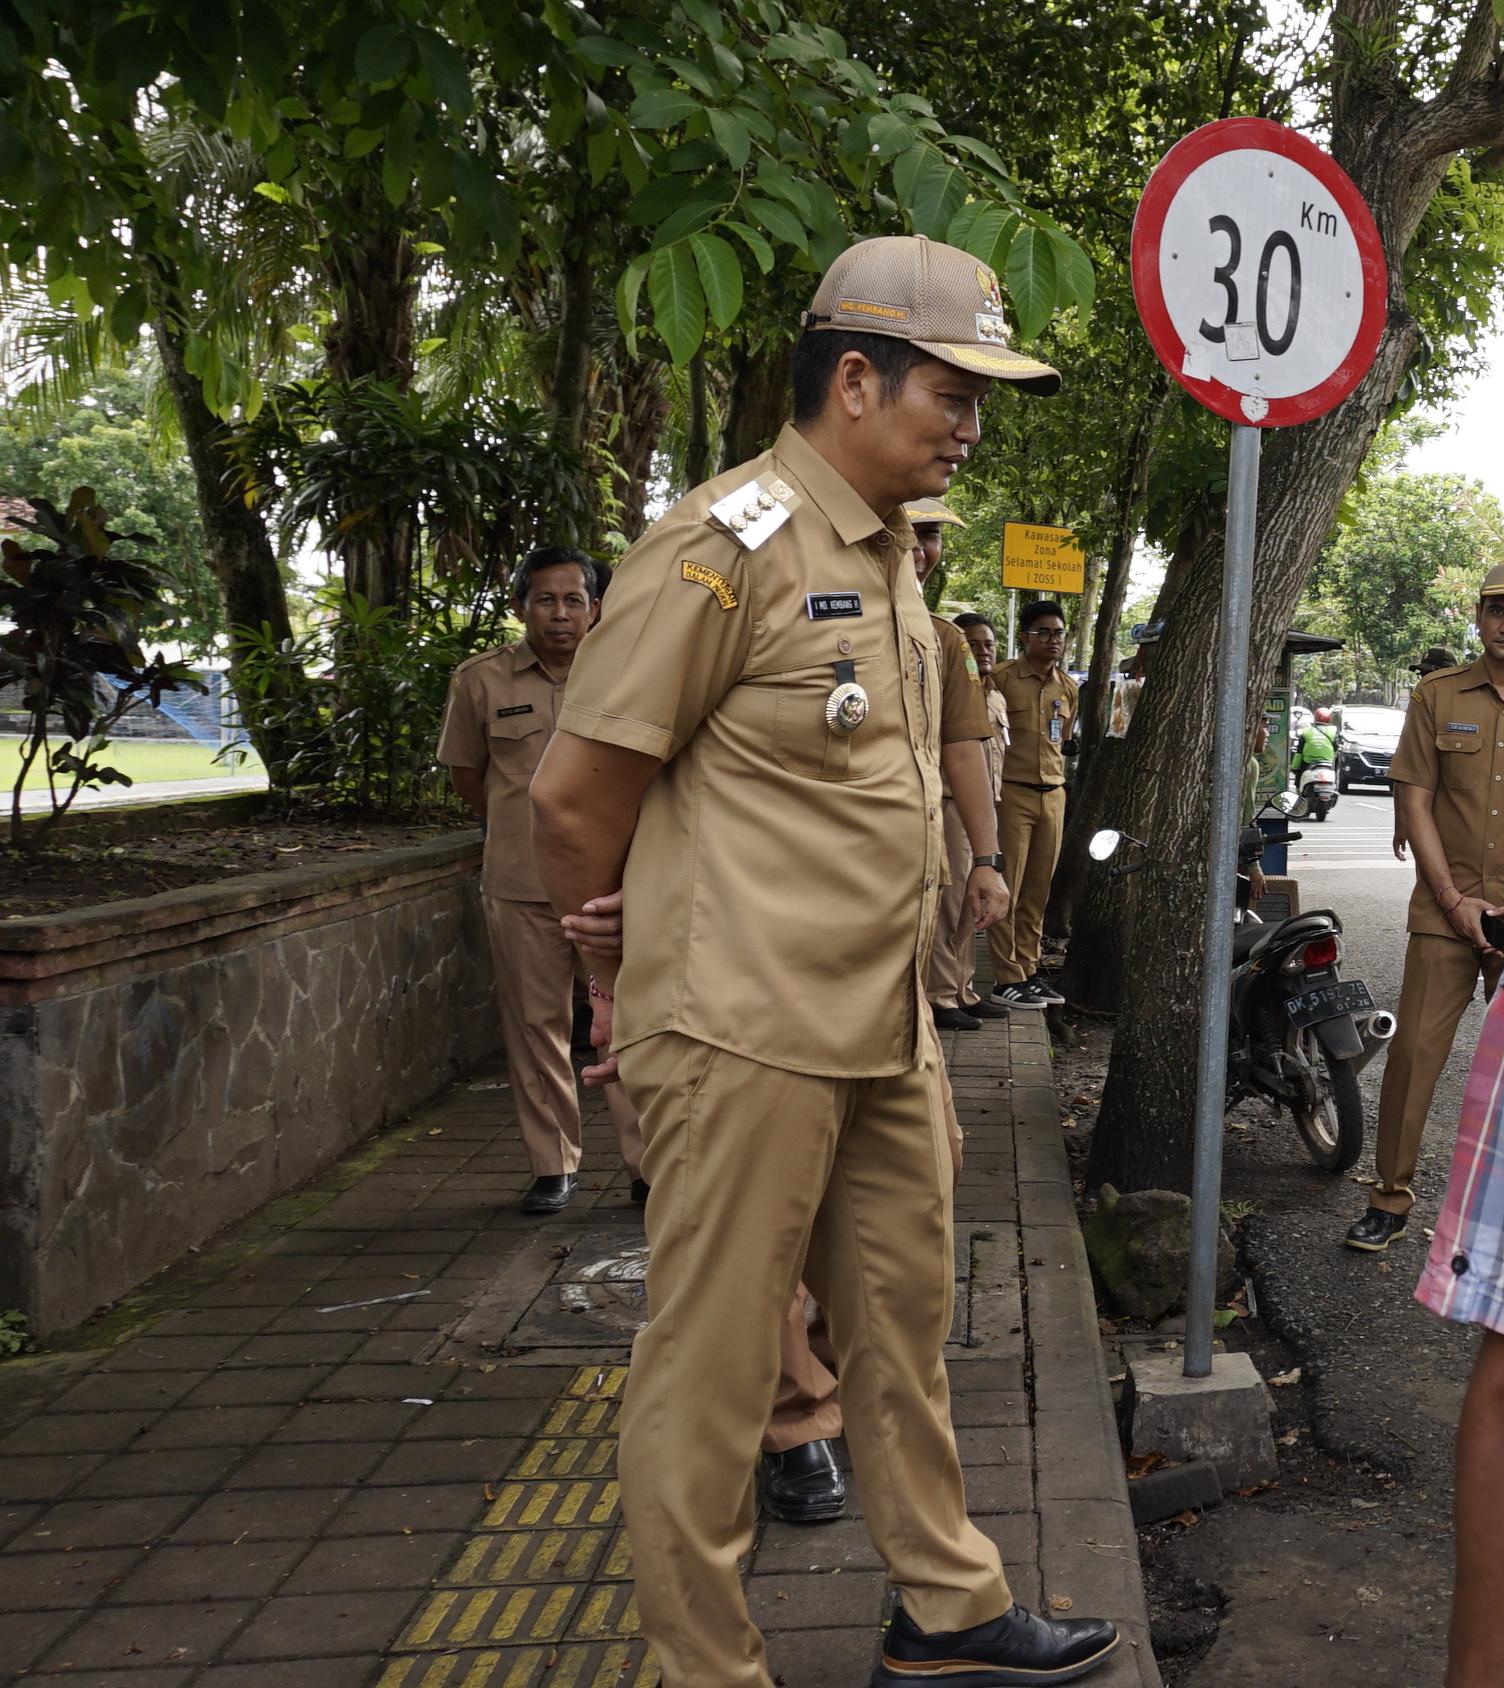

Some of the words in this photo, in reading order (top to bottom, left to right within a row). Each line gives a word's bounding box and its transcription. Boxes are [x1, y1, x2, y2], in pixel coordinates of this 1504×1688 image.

[1198, 214, 1302, 356] 30
[1300, 201, 1338, 237] Km
[1034, 544, 1057, 556] Zona
[1005, 556, 1043, 569] Selamat
[1046, 560, 1082, 573] Sekolah
[1033, 573, 1055, 585] ZOSS
[1286, 996, 1307, 1015] DK
